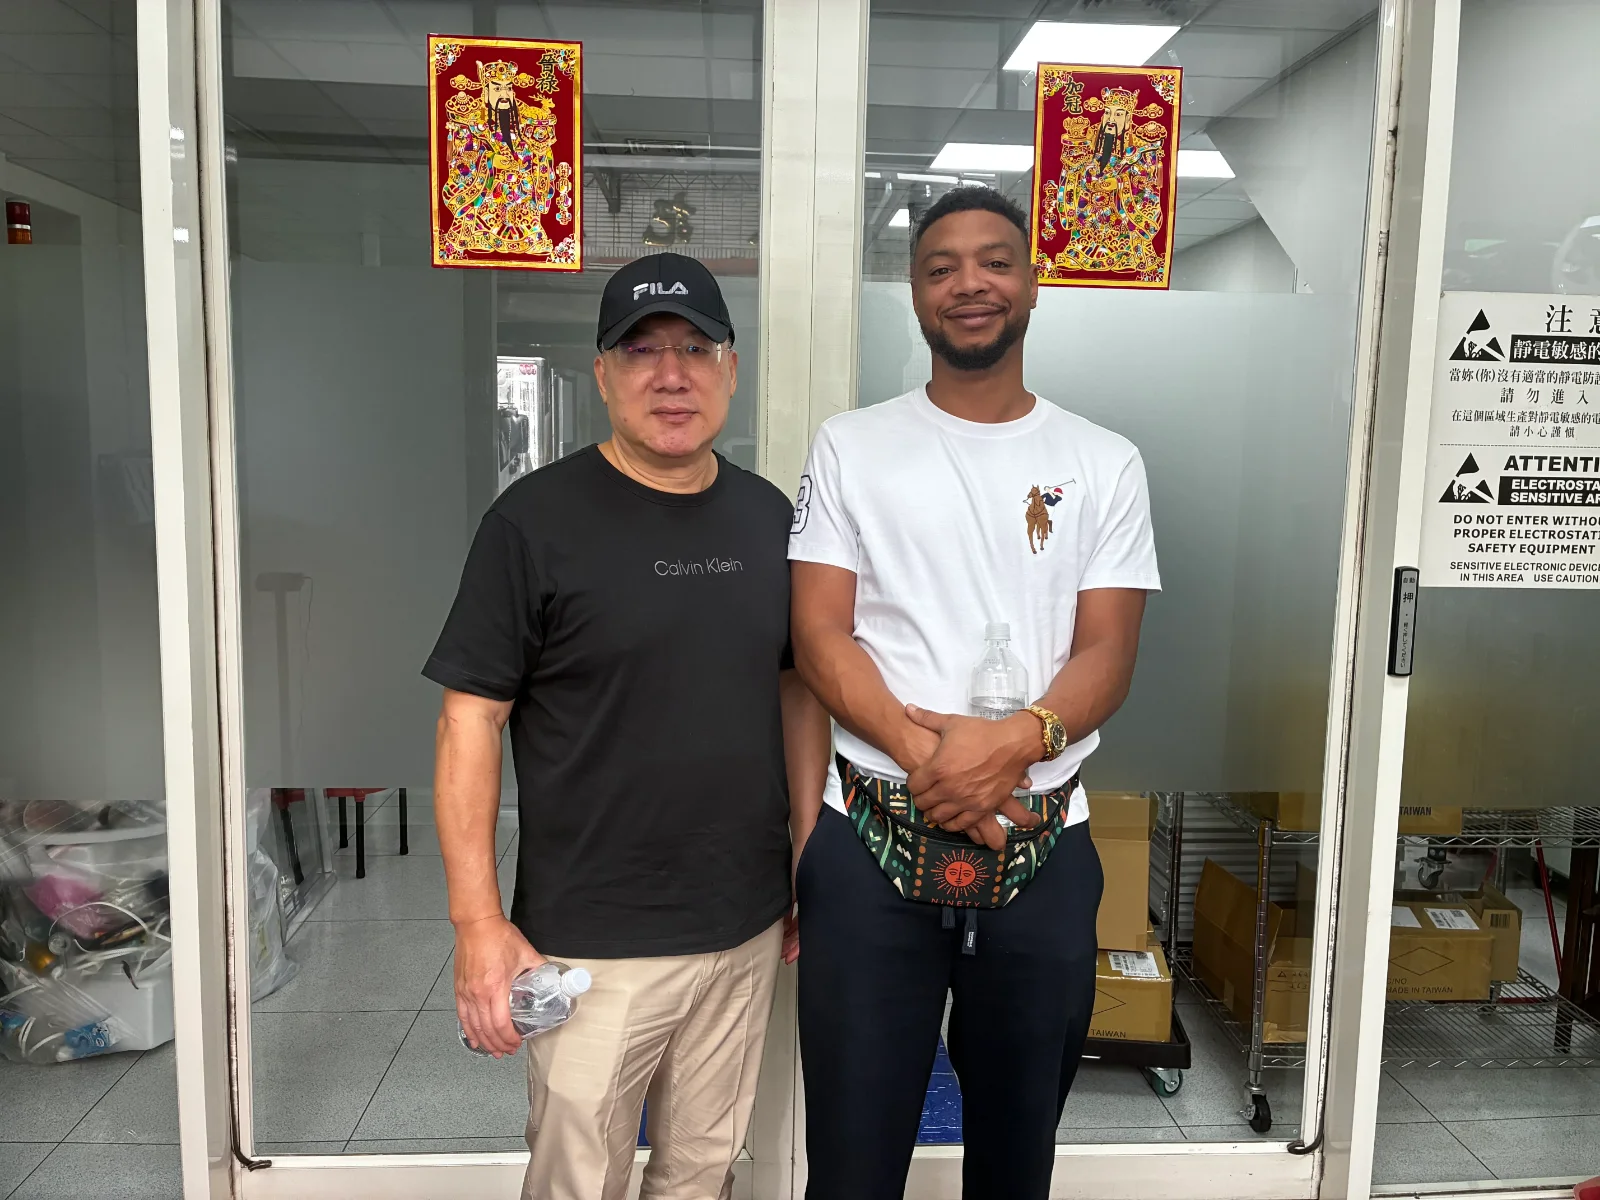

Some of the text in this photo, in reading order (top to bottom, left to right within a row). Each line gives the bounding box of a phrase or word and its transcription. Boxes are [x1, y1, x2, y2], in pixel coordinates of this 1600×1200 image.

[1062, 77, 1084, 114] 加冠
[633, 281, 689, 301] FILA
[1500, 387, 1589, 405] 請勿進入
[1503, 455, 1600, 472] ATTENTI
[1511, 478, 1600, 491] ELECTROSTA
[1510, 492, 1583, 504] SENSITIVE
[1453, 514, 1600, 526] DO NOT ENTER WITHO
[1453, 529, 1506, 539] PROPER
[1468, 543, 1596, 555] SAFETY EQUIPMENT
[654, 557, 743, 576] Calvin Klein
[1450, 561, 1502, 570] SENSITIVE
[1504, 562, 1566, 571] ELECTRONIC
[1460, 573, 1599, 583] IN THIS AREA USE CAUTION
[1403, 592, 1414, 603] 押
[1399, 806, 1432, 816] TAIWAN
[931, 898, 981, 907] NINETY
[1411, 986, 1420, 994] IN
[1422, 986, 1453, 994] TAIWAN
[1090, 1028, 1127, 1038] TAIWAN
